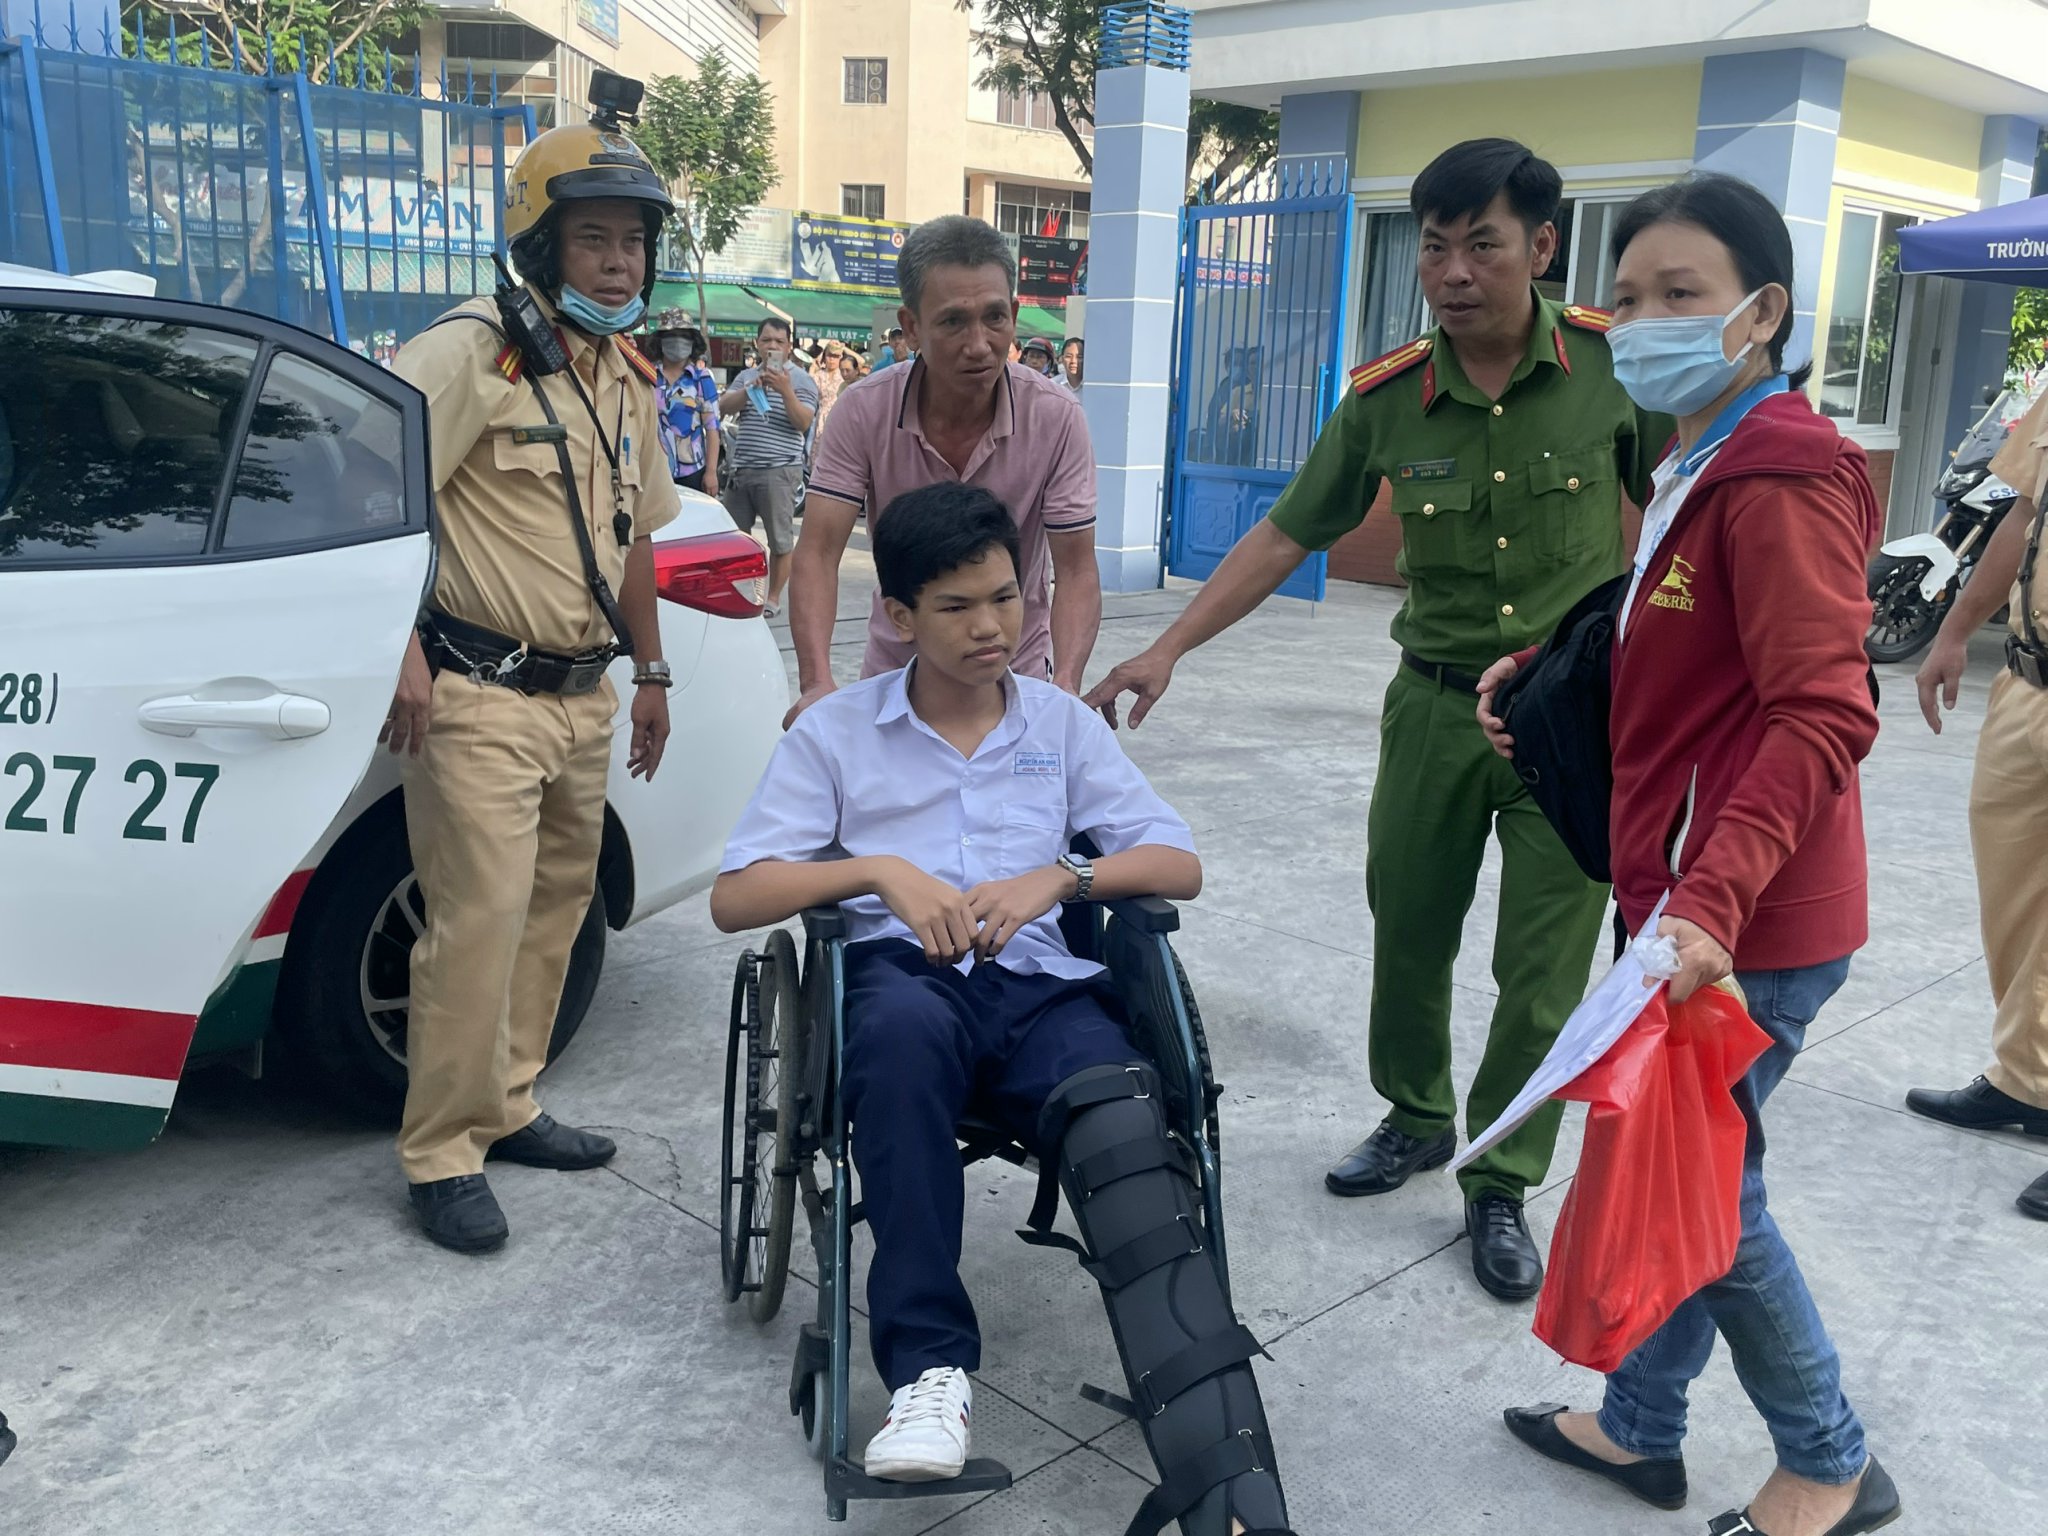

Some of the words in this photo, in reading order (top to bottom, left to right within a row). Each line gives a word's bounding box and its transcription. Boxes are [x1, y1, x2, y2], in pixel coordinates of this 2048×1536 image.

[1986, 237, 2048, 259] TRƯỜN
[4, 751, 96, 834] 27
[122, 758, 220, 844] 27
